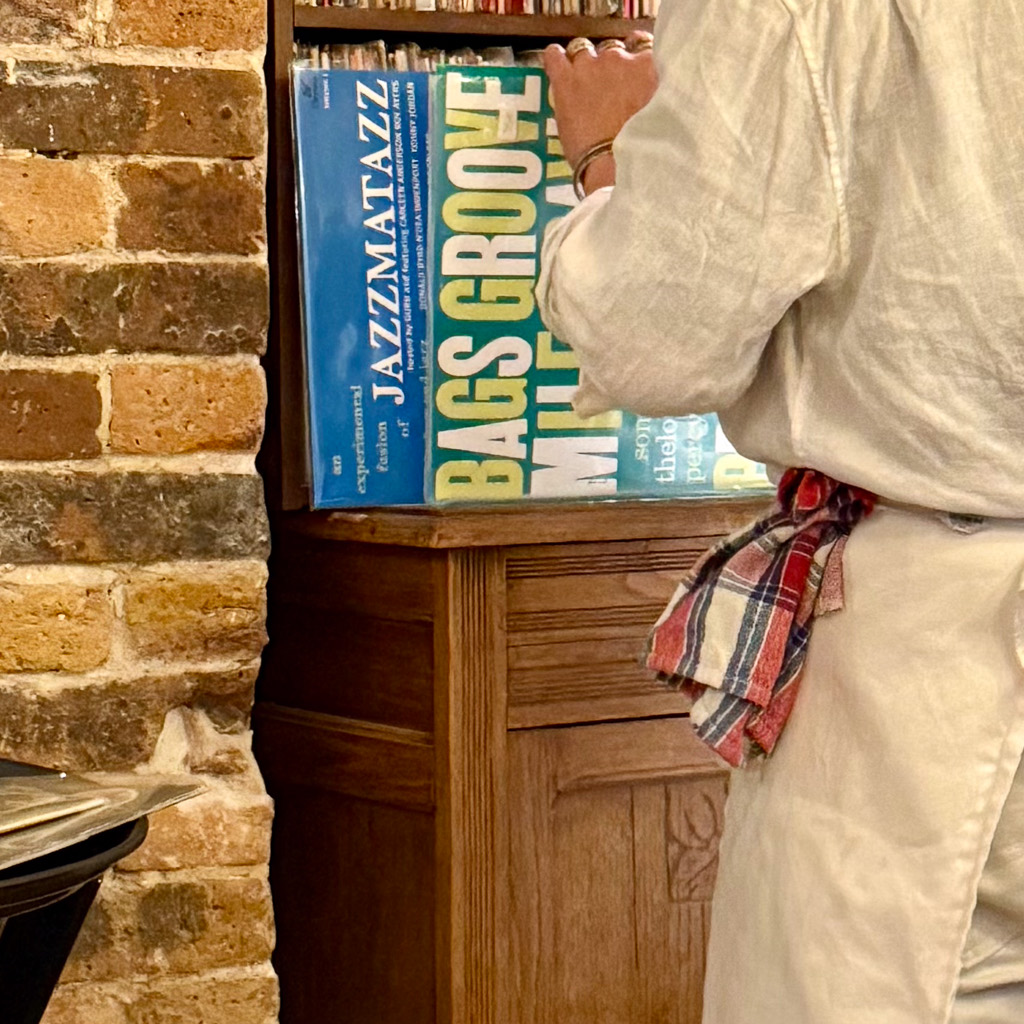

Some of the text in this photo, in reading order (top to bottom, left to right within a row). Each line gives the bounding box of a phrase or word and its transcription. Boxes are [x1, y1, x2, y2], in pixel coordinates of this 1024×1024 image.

[356, 79, 405, 407] JAZZMATAZZ
[434, 71, 543, 501] BAGS GROOVE
[375, 421, 389, 473] fusion
[396, 417, 410, 438] of
